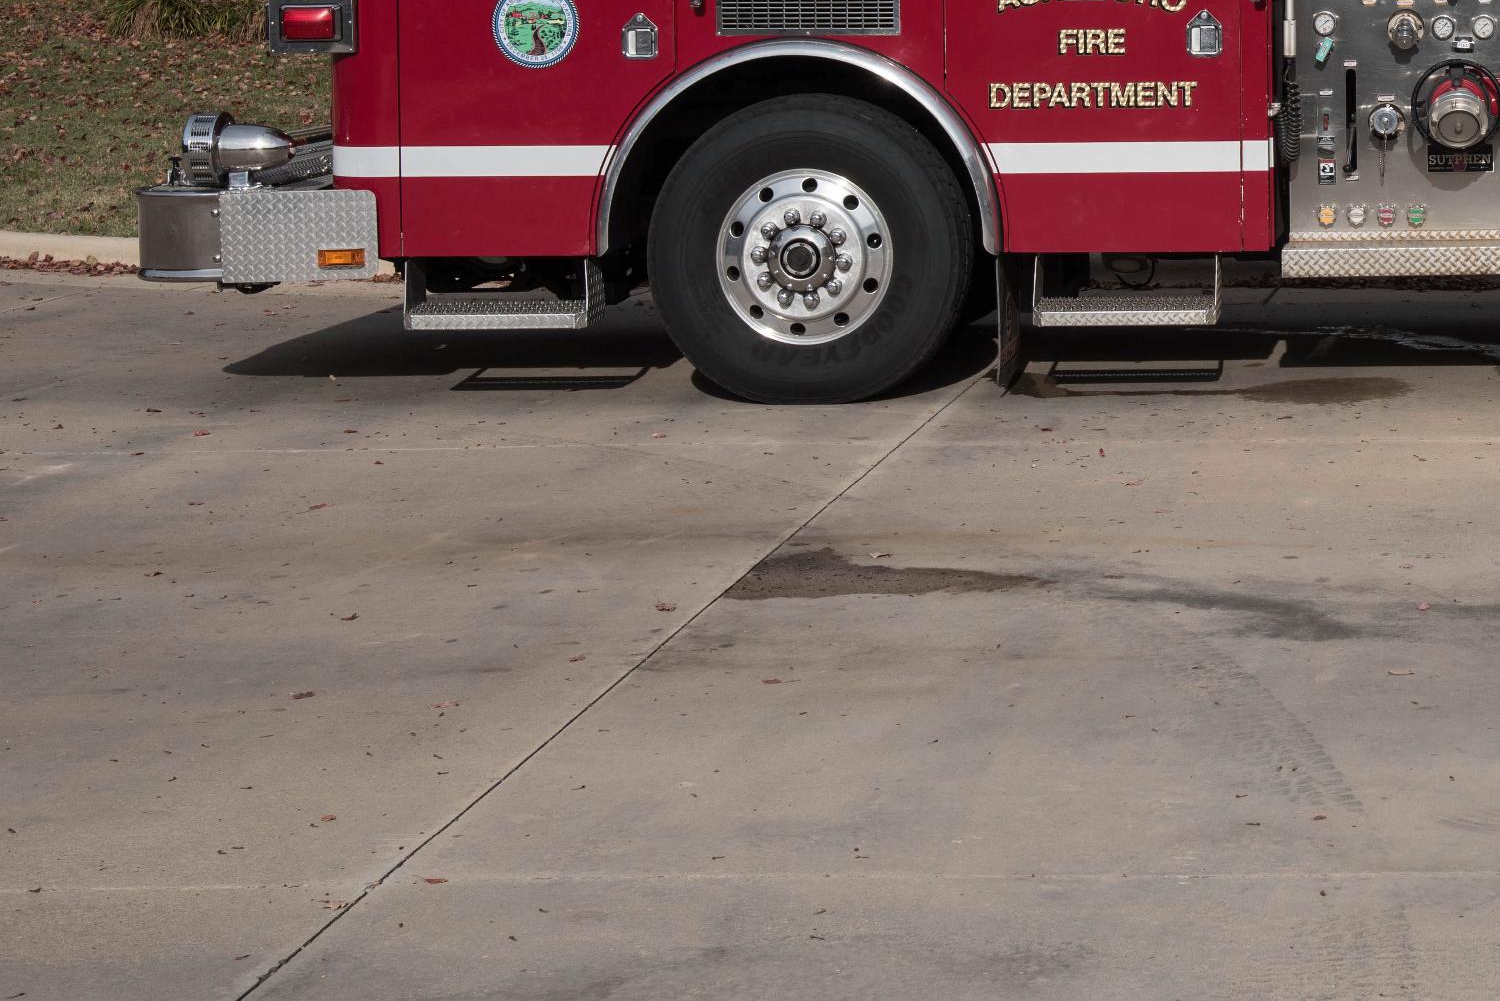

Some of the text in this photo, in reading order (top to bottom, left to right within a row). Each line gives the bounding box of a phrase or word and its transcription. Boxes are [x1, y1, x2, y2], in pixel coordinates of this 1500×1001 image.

[506, 42, 539, 61] DECEMBER
[1058, 28, 1126, 55] FIRE
[989, 81, 1198, 108] DEPARTMENT
[1428, 153, 1492, 165] SUTPHEN
